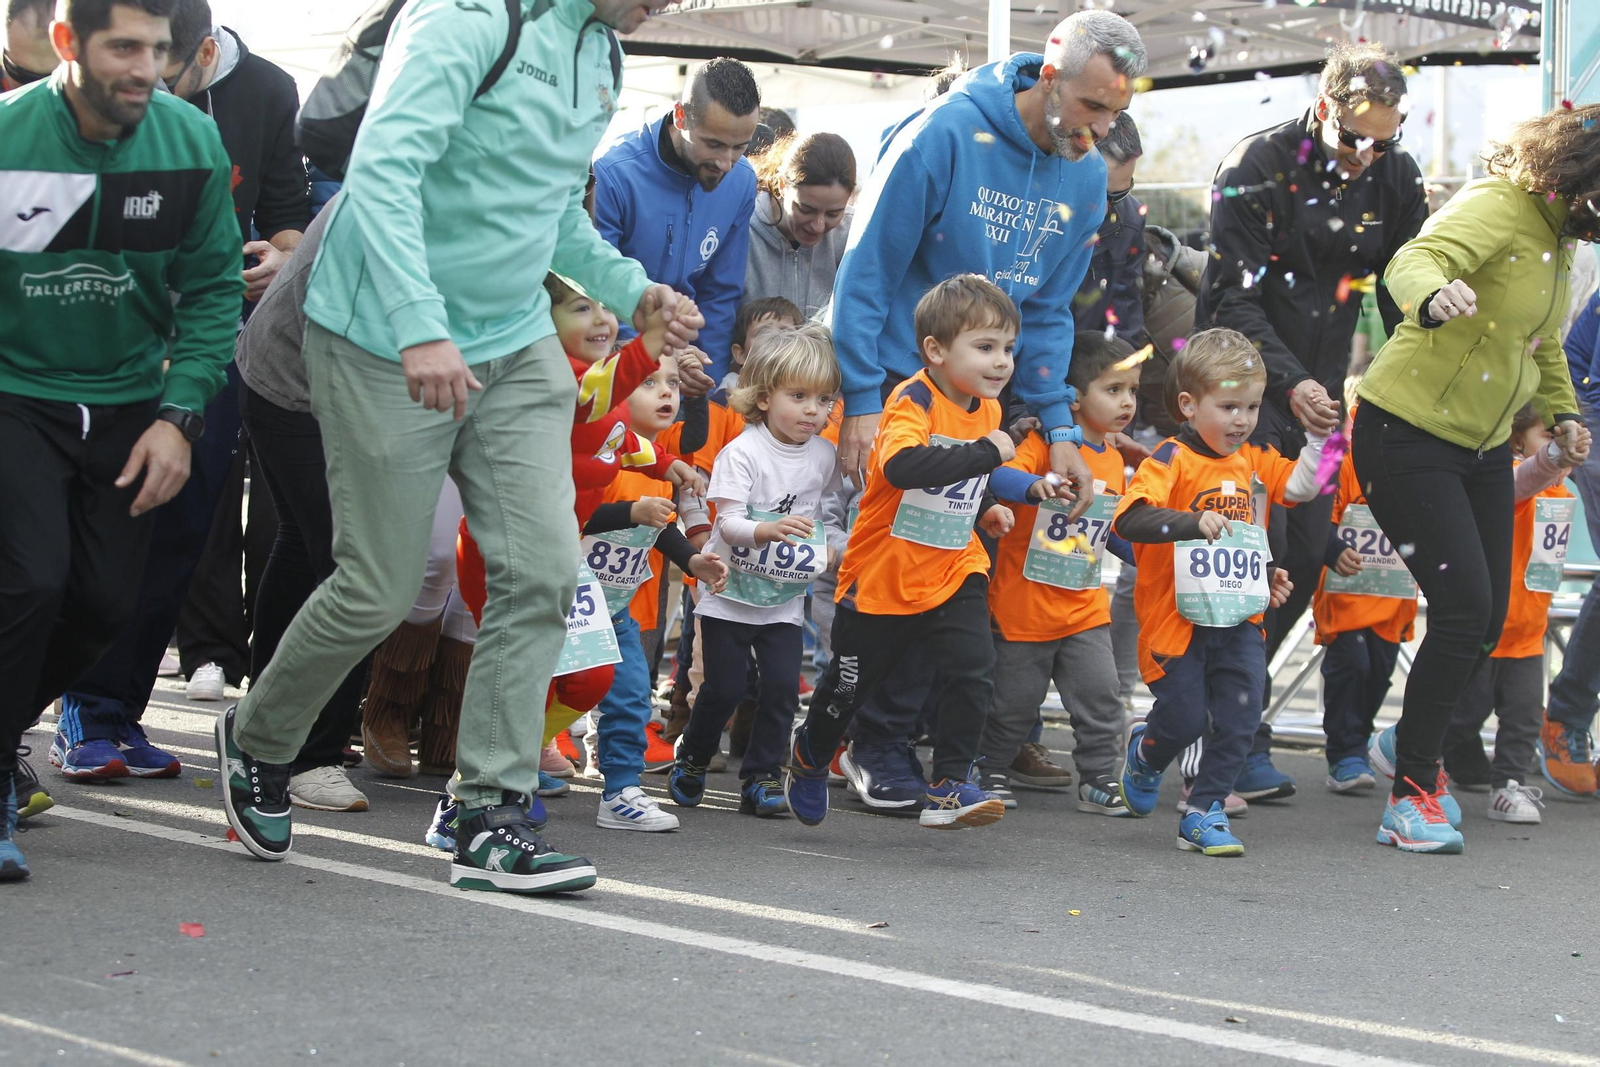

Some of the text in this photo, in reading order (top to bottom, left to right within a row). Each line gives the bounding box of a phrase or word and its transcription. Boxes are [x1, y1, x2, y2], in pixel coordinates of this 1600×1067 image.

[922, 473, 985, 501] 27
[1341, 527, 1395, 557] 820
[1189, 547, 1262, 581] 8096
[1362, 555, 1397, 565] EJANDRO
[591, 570, 615, 582] ABLO
[1219, 579, 1243, 589] DIEGO
[567, 618, 590, 630] HINA
